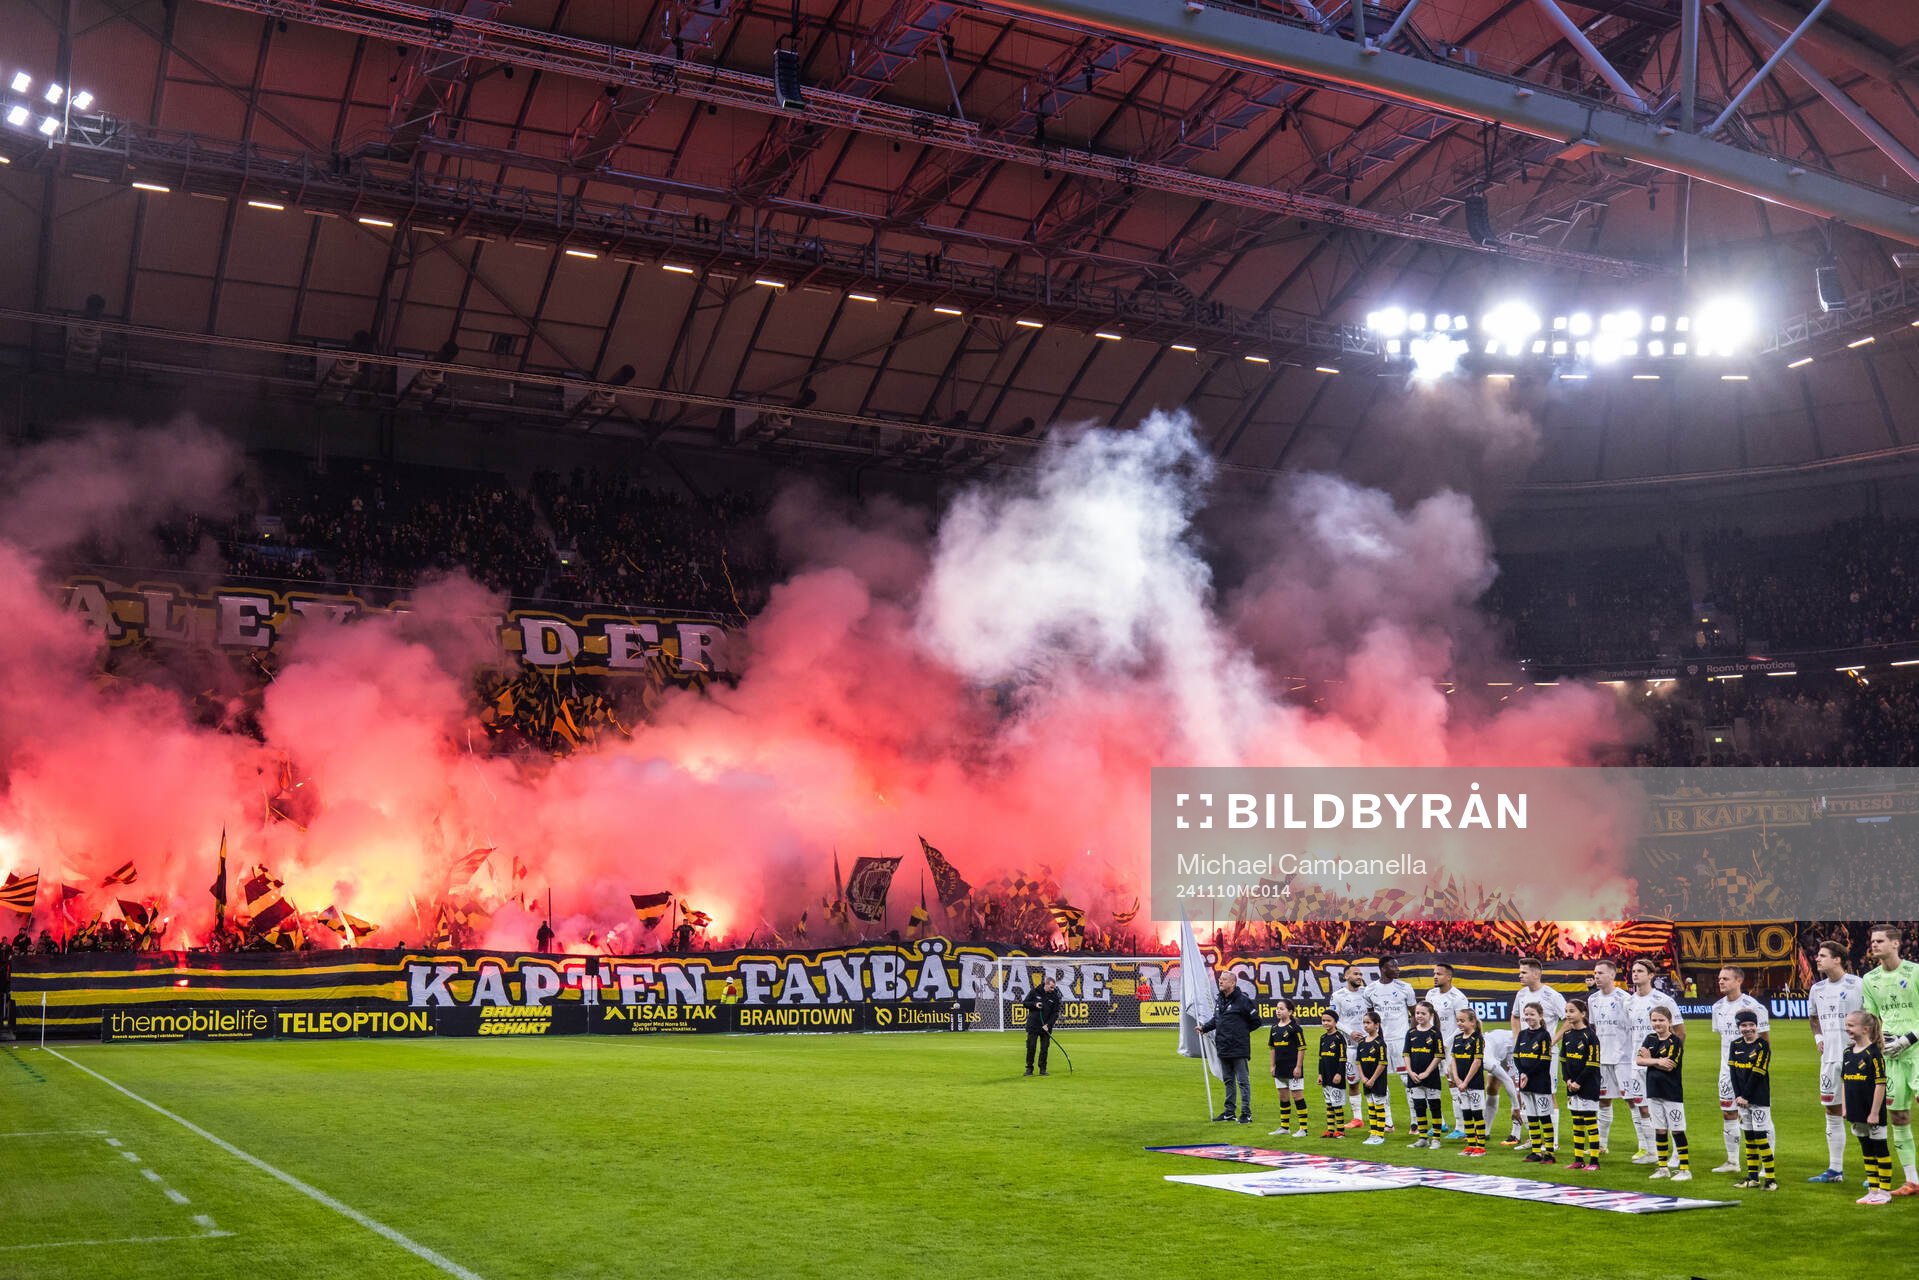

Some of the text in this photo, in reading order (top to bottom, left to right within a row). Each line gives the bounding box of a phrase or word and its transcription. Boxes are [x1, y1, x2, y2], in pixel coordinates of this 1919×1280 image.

[64, 584, 728, 672] ALEDER
[1601, 667, 1677, 679] trawberry Arena
[1707, 661, 1796, 673] Room for emotions
[1695, 803, 1809, 829] KAPTEN
[1680, 925, 1793, 961] MILO
[408, 964, 705, 1006] KAPTEN
[740, 942, 1109, 1004] FANBÄRARE
[480, 1005, 553, 1018] BRUNNA
[626, 1005, 717, 1020] TISAB TAK
[740, 1008, 853, 1026] BRANDTOWN
[898, 1007, 950, 1024] Ellénius
[111, 1010, 267, 1032] themobilelife
[278, 1011, 434, 1033] TELEOPTION.
[478, 1022, 552, 1035] SCHAKT
